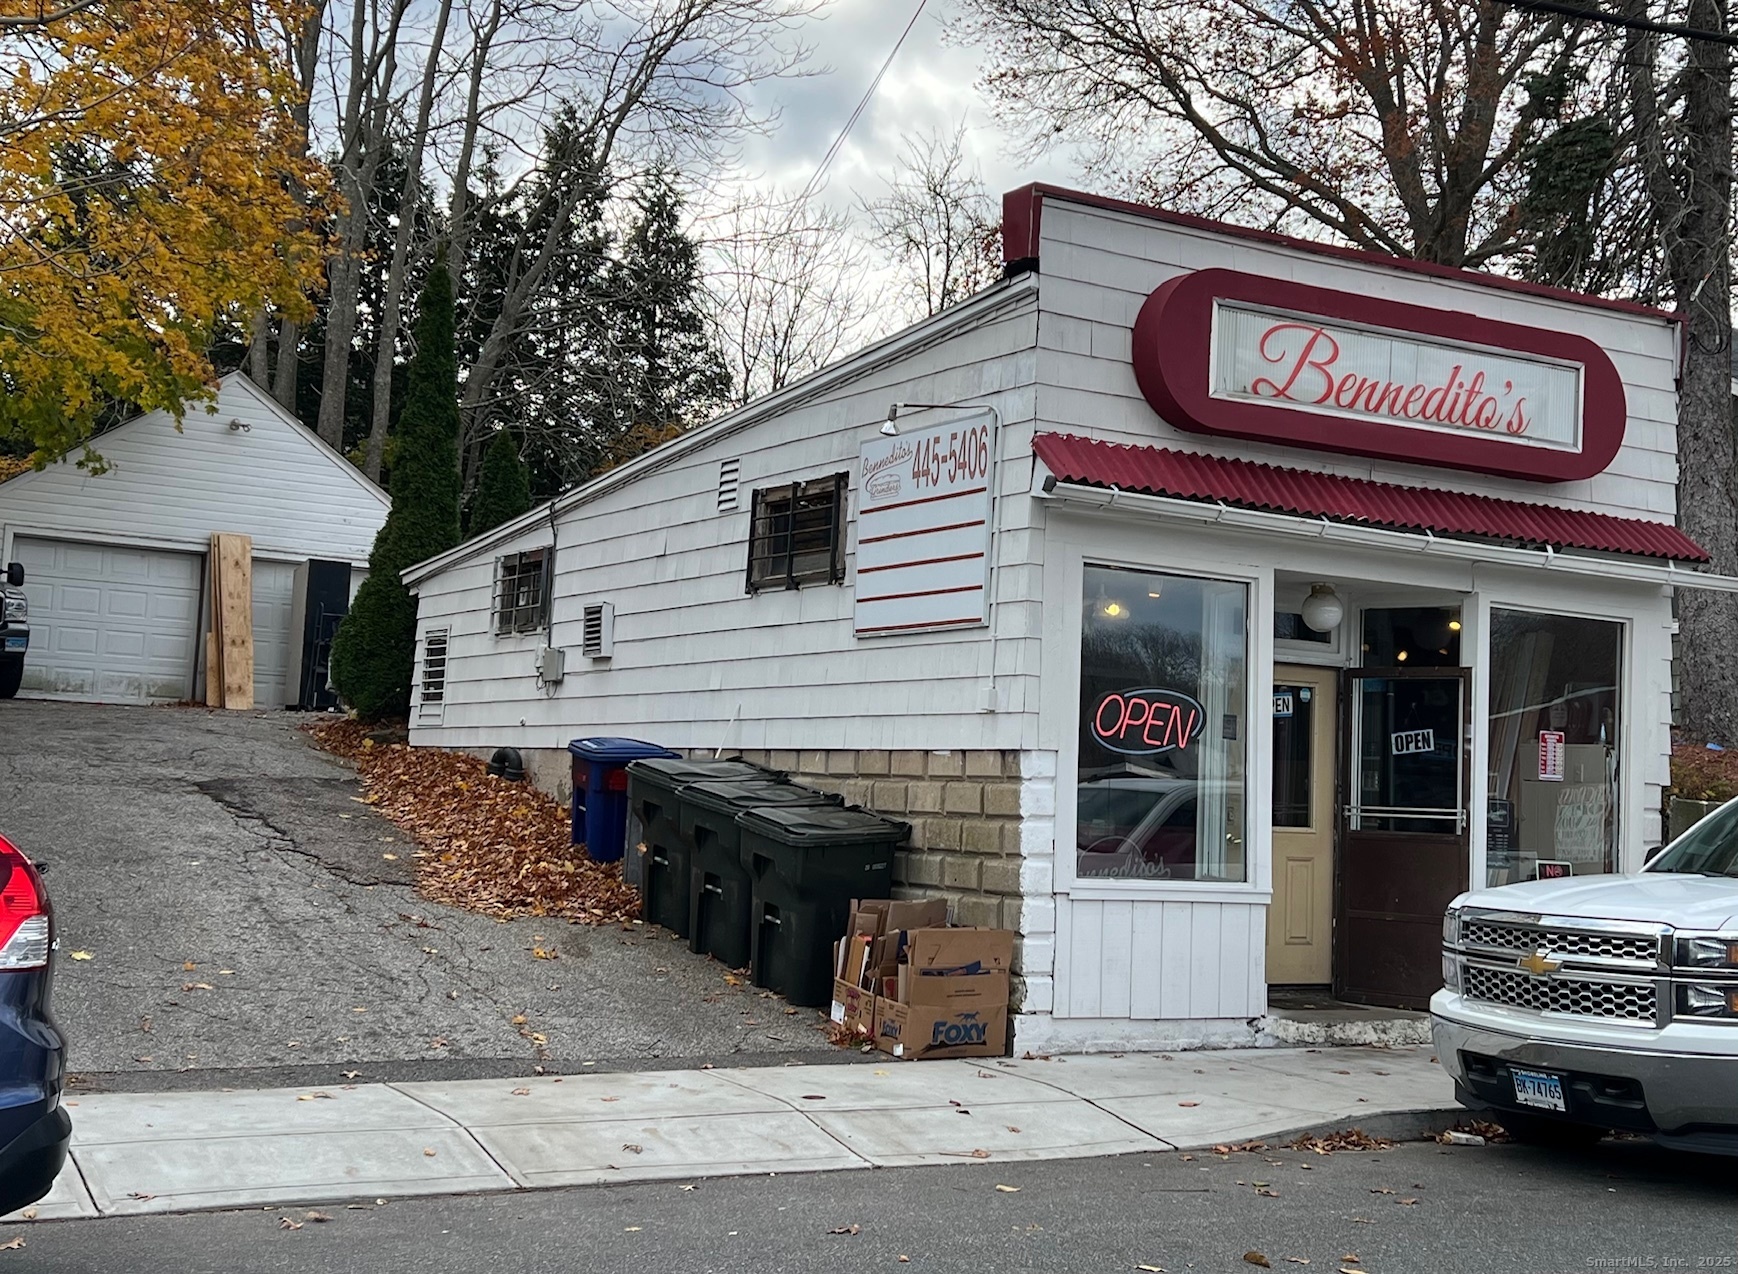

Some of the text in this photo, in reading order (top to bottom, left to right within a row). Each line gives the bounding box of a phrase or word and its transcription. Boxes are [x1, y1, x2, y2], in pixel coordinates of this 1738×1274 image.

[1252, 322, 1532, 435] Bennedito's
[912, 424, 988, 489] 445-5406
[1096, 693, 1196, 749] OPEN
[1273, 697, 1290, 713] EN
[1394, 731, 1432, 753] OPEN
[932, 1021, 988, 1044] FOXY
